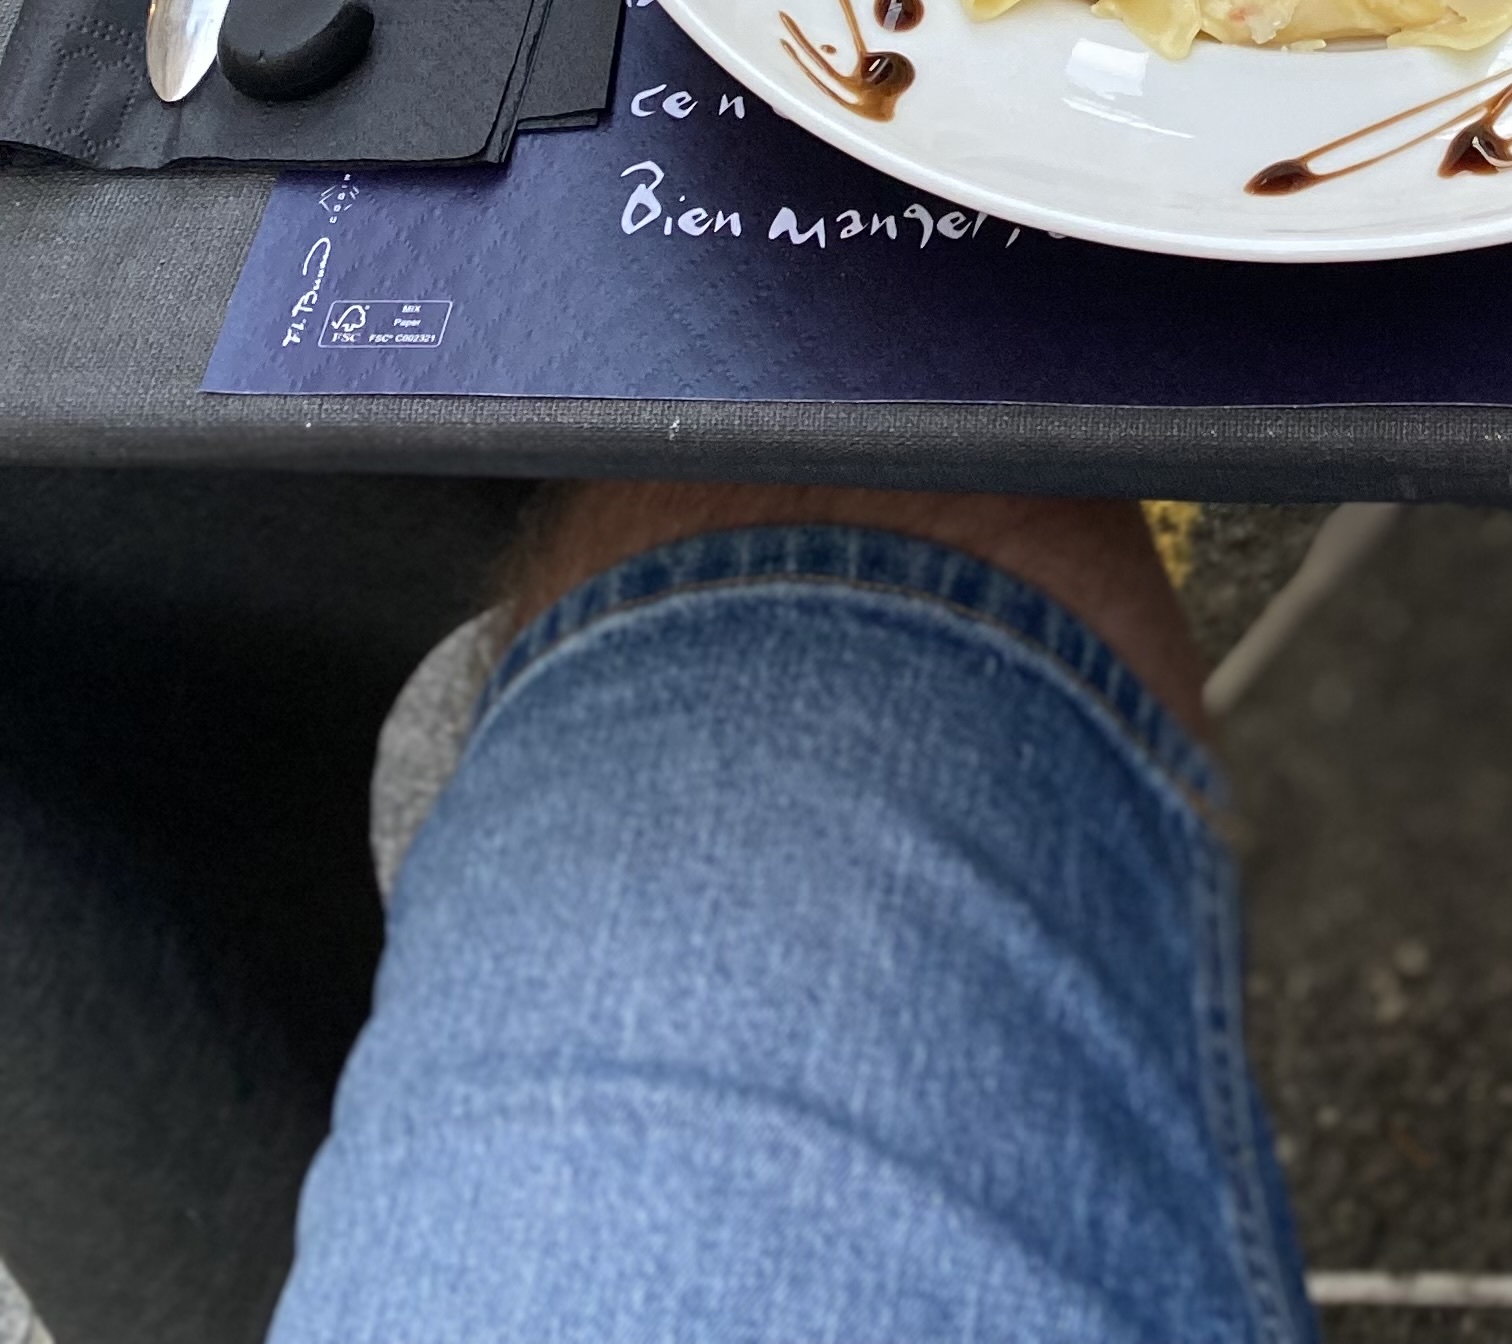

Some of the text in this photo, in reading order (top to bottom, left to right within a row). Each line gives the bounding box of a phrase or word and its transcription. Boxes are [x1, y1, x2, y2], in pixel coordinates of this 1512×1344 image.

[630, 84, 698, 119] ce
[620, 160, 742, 237] Bien
[393, 318, 422, 328] Paper
